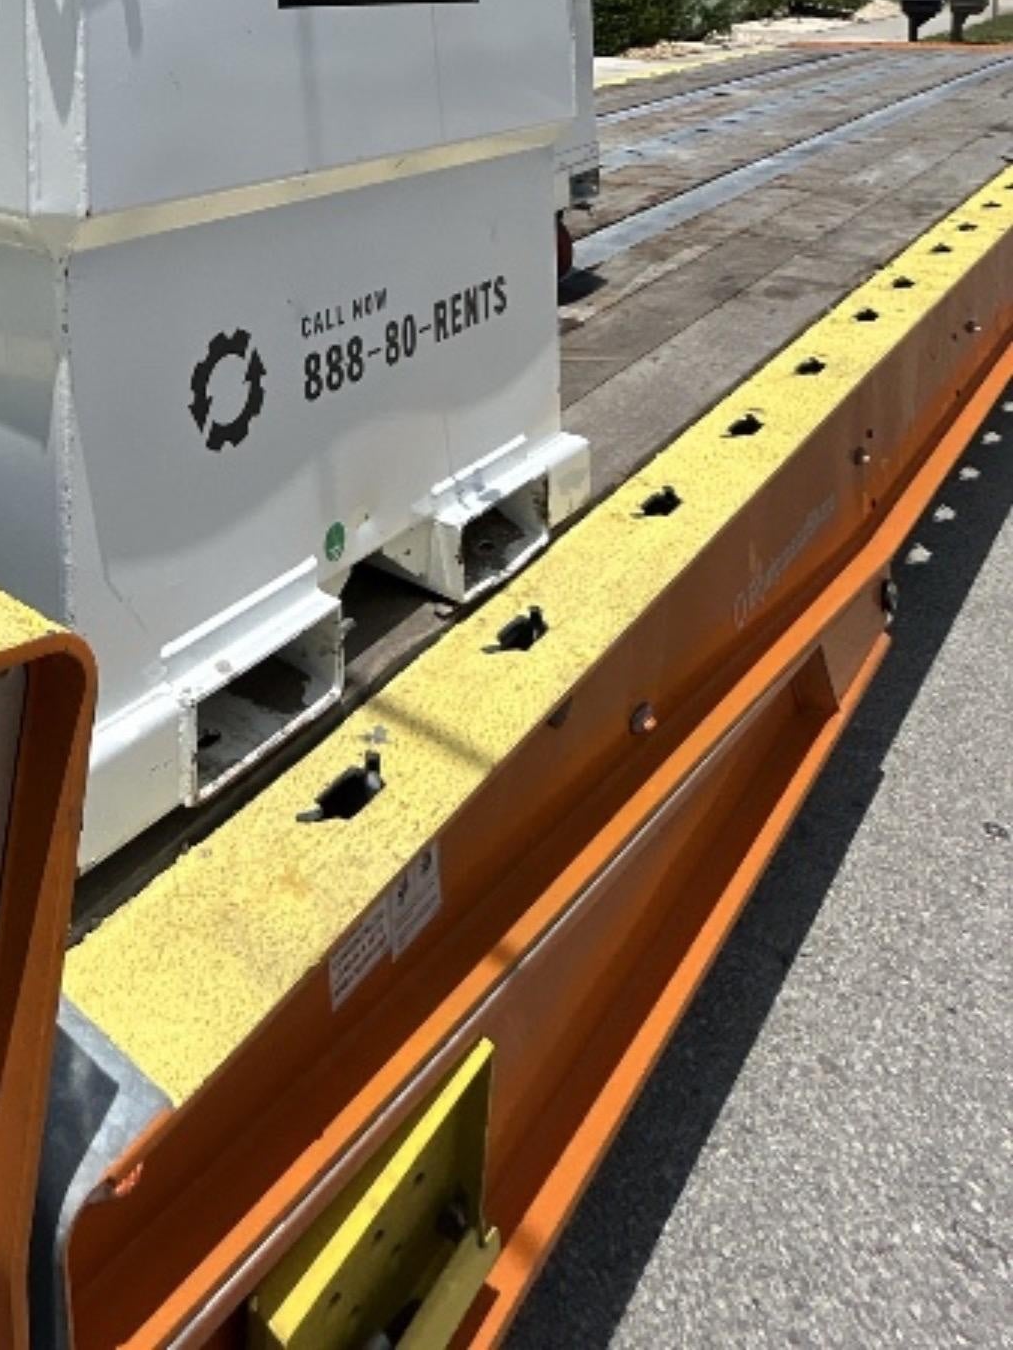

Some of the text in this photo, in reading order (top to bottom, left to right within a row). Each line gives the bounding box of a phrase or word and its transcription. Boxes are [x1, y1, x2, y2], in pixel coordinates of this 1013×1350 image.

[300, 286, 388, 340] CALL NOW
[303, 274, 508, 402] 888-80-RENTS
